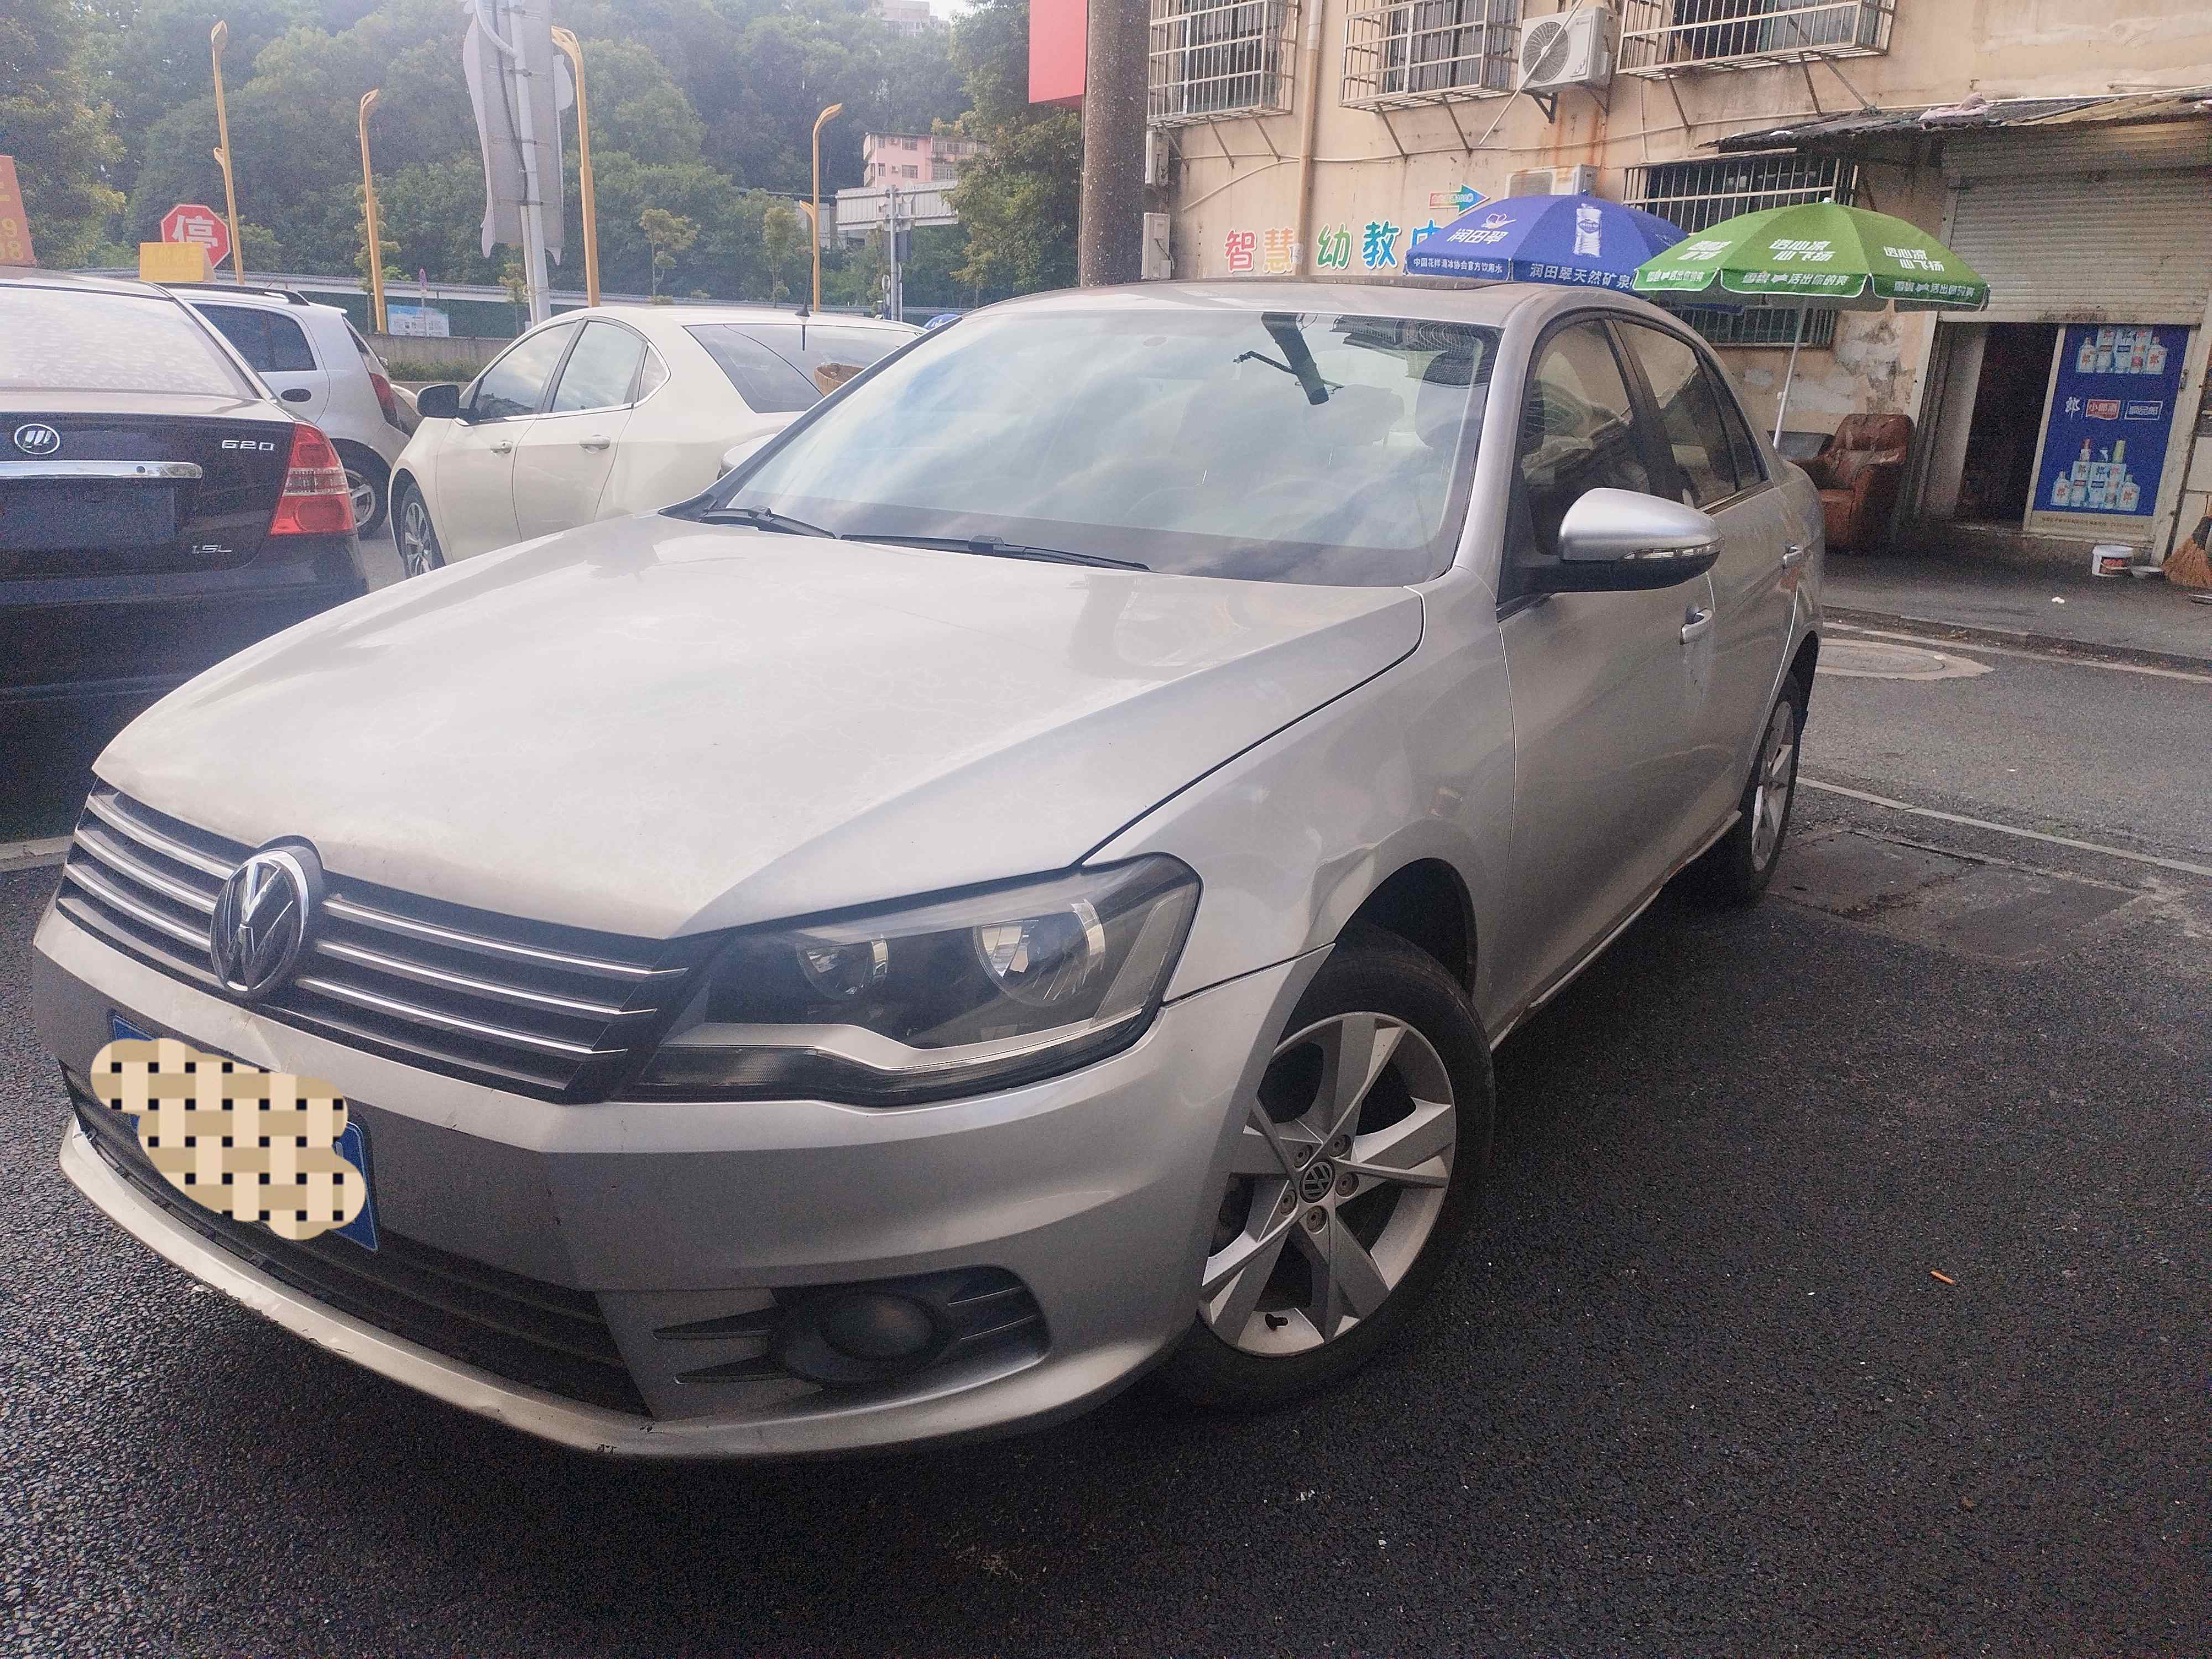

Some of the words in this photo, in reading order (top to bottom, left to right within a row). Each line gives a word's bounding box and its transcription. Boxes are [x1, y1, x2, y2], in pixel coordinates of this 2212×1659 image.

[172, 214, 218, 248] 停
[1447, 228, 1509, 244] 润田翠
[222, 440, 275, 451] 620
